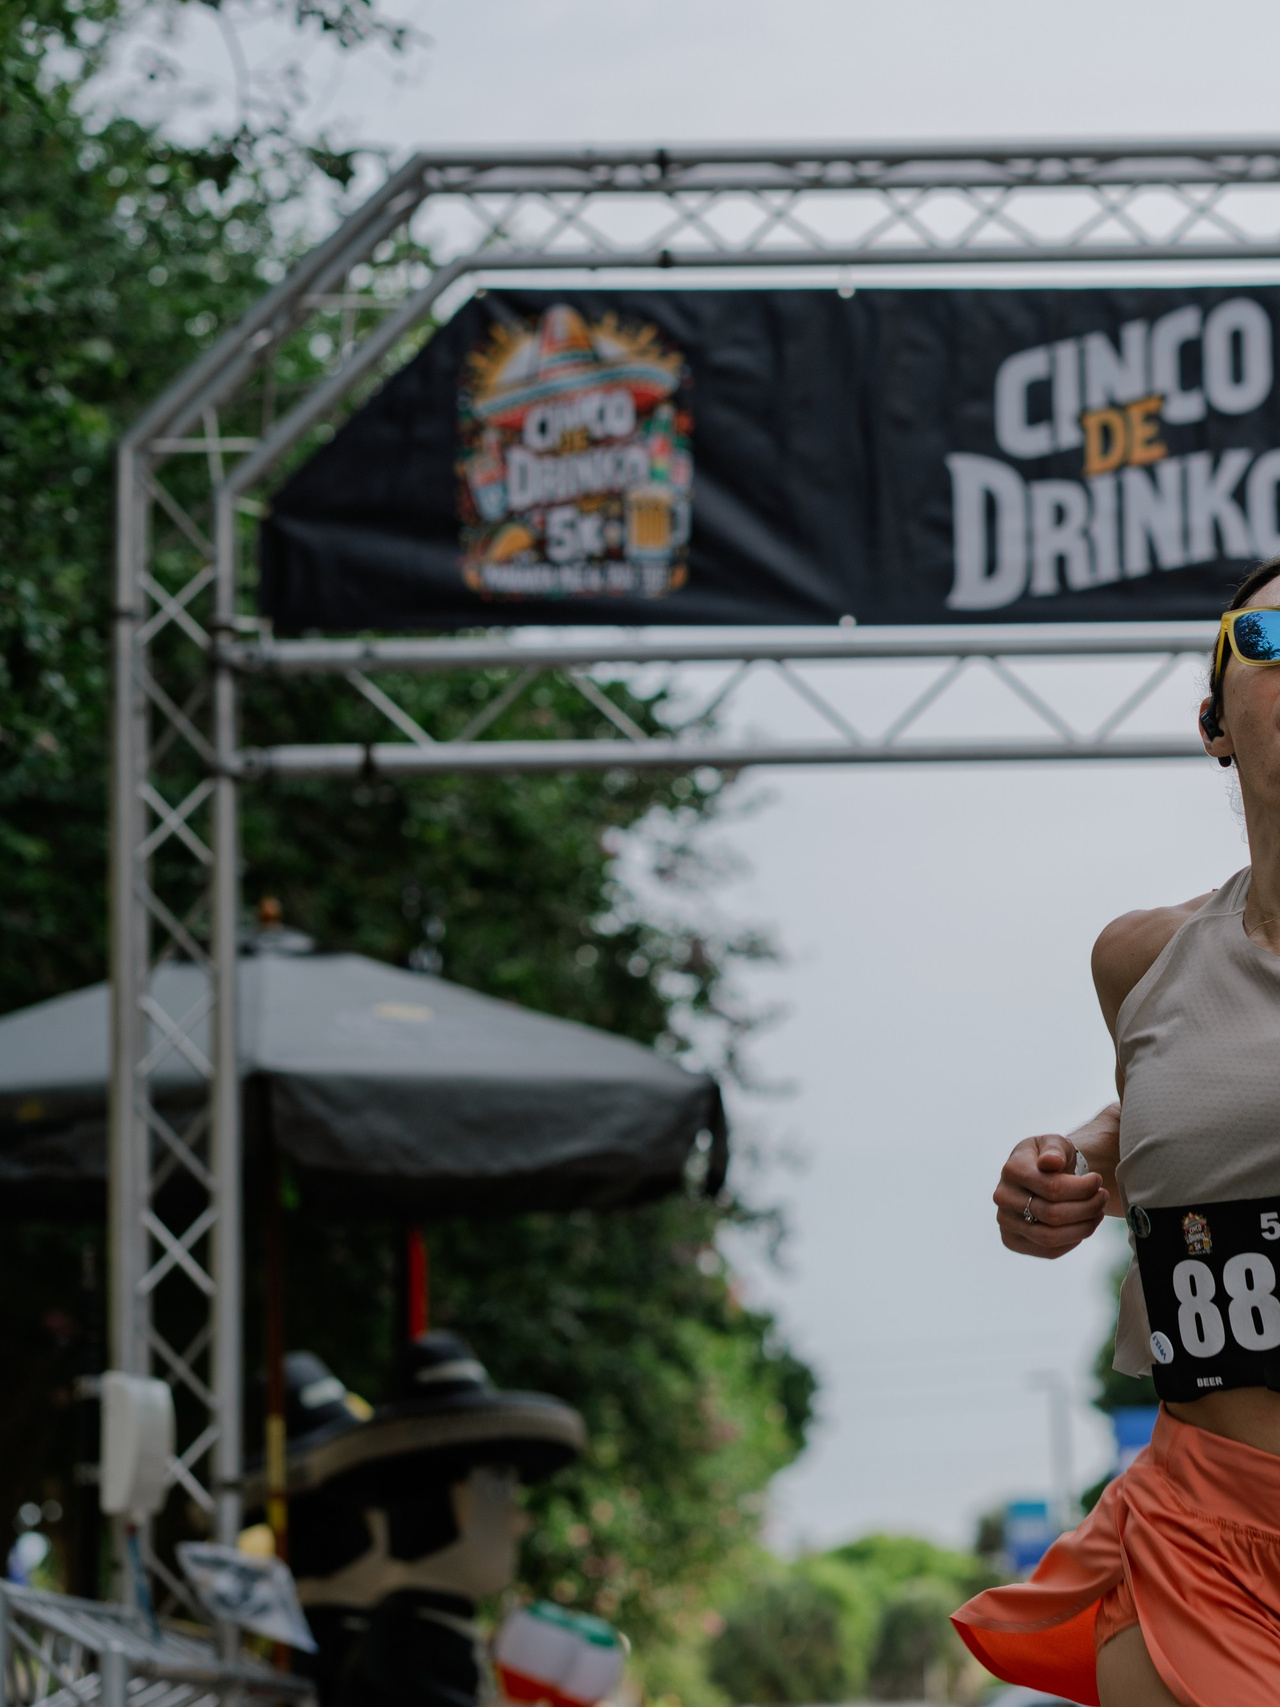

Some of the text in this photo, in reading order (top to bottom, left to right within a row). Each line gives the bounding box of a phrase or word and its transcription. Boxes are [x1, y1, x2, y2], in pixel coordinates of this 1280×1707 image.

[994, 296, 1273, 460] CINCO
[1080, 394, 1169, 476] DE
[1196, 1376, 1223, 1388] BEER
